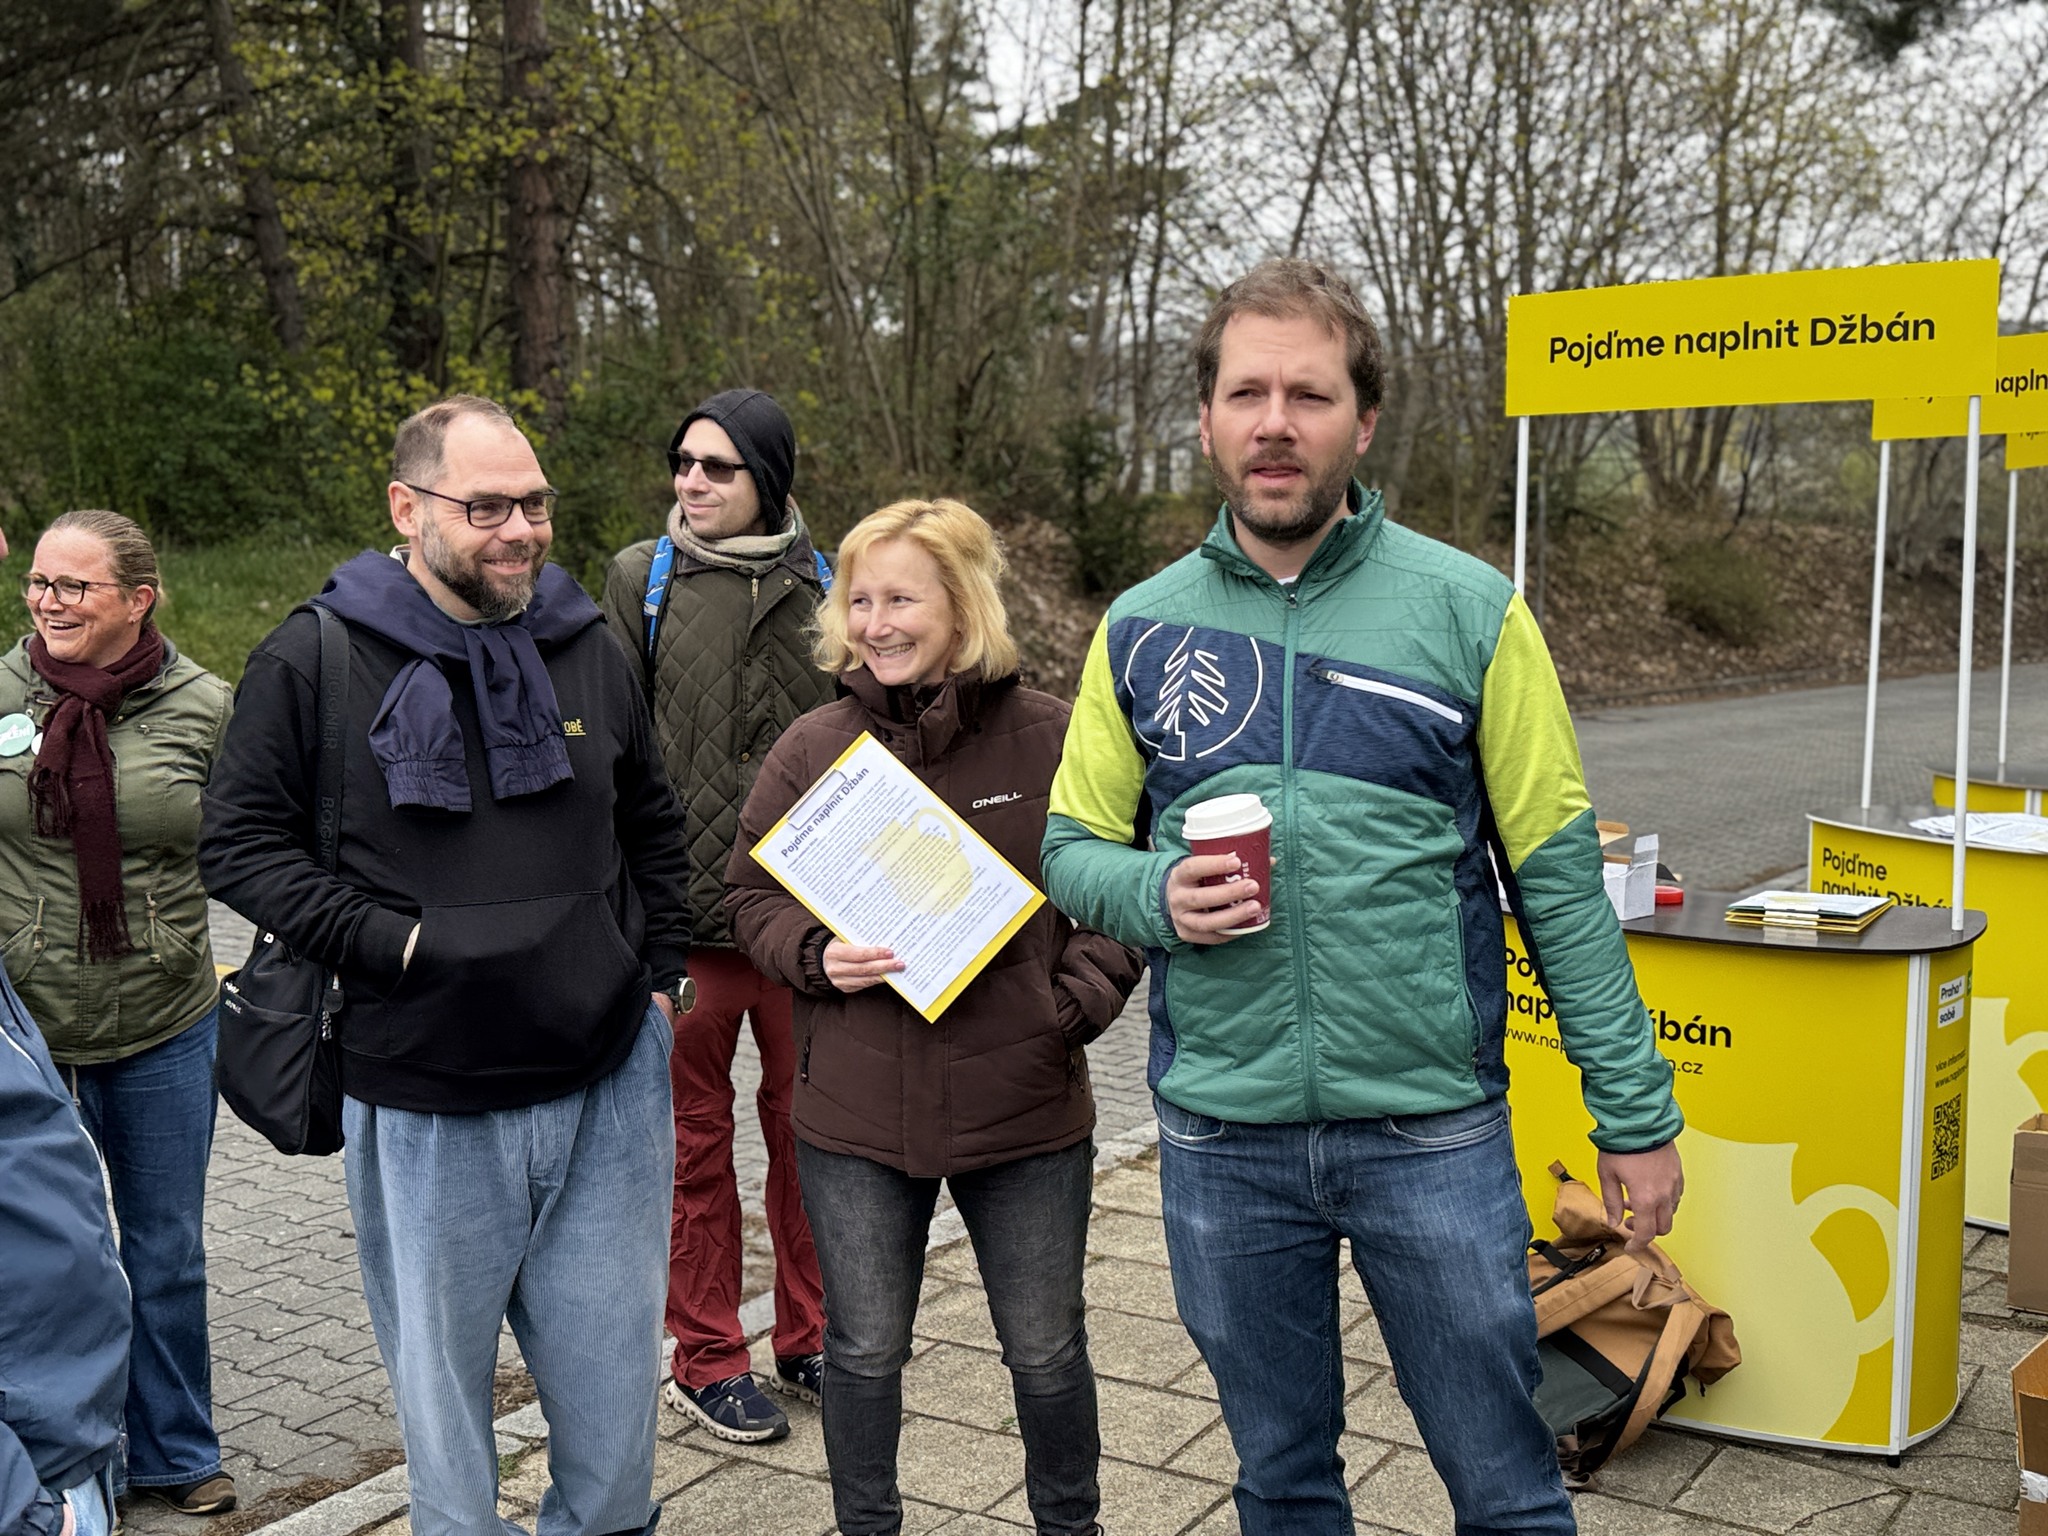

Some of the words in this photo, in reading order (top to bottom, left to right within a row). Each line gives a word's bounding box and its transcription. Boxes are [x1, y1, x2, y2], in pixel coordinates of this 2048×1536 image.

[1549, 329, 1665, 369] Pojďme
[1674, 318, 1799, 360] naplnit
[1810, 311, 1936, 347] Džbán
[563, 718, 584, 733] OBĚ
[781, 824, 815, 858] Pojďme
[813, 794, 844, 827] naplnit
[840, 767, 870, 796] Džbán
[1822, 847, 1888, 881] Pojďme
[1648, 1008, 1732, 1049] bán
